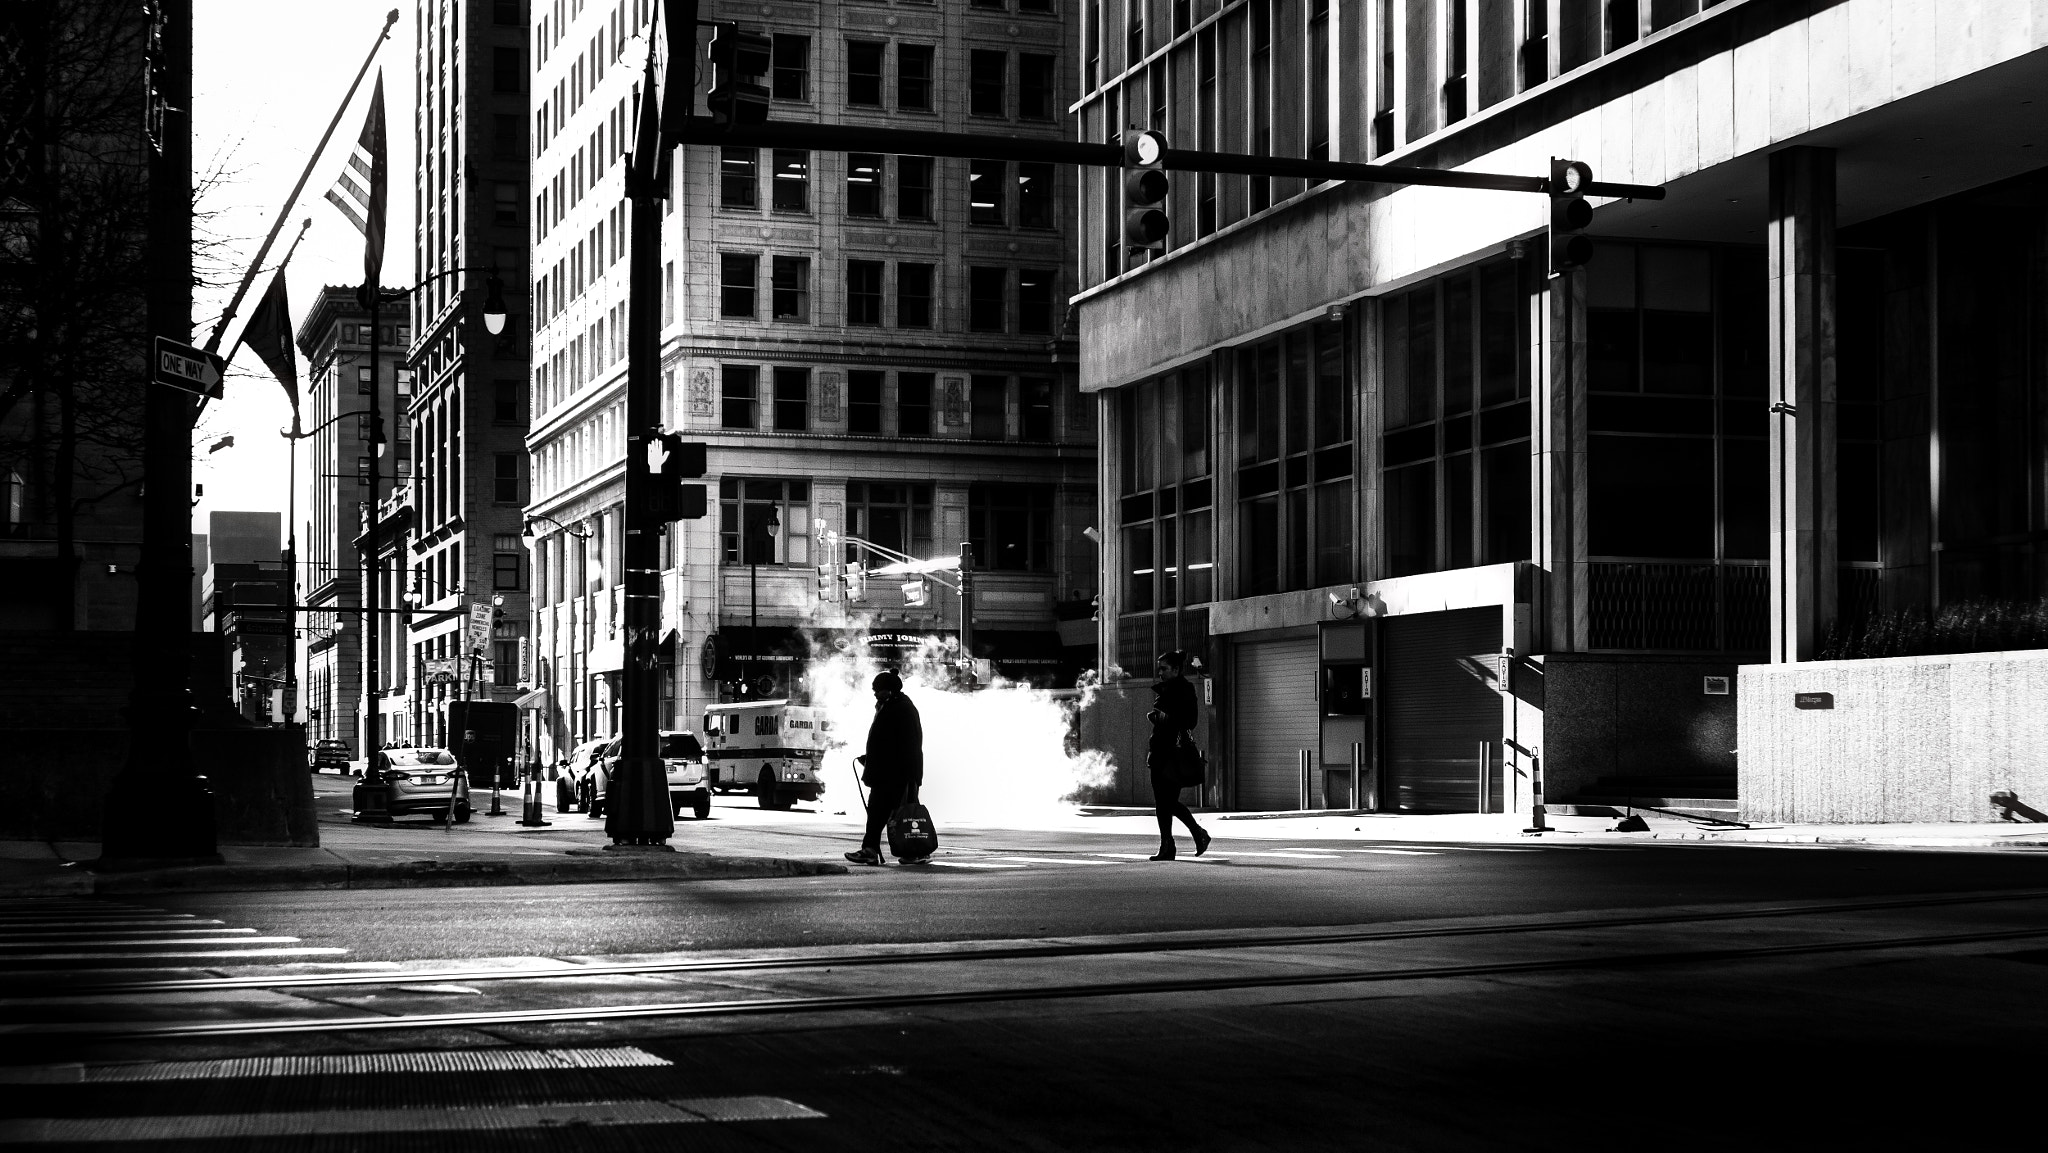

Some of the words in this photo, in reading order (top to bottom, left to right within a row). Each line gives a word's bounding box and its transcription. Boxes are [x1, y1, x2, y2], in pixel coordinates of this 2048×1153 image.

[163, 353, 182, 375] ONE
[184, 360, 204, 380] WAY
[897, 634, 927, 645] JOHN
[755, 715, 778, 735] GARDA
[789, 720, 813, 729] GARDA
